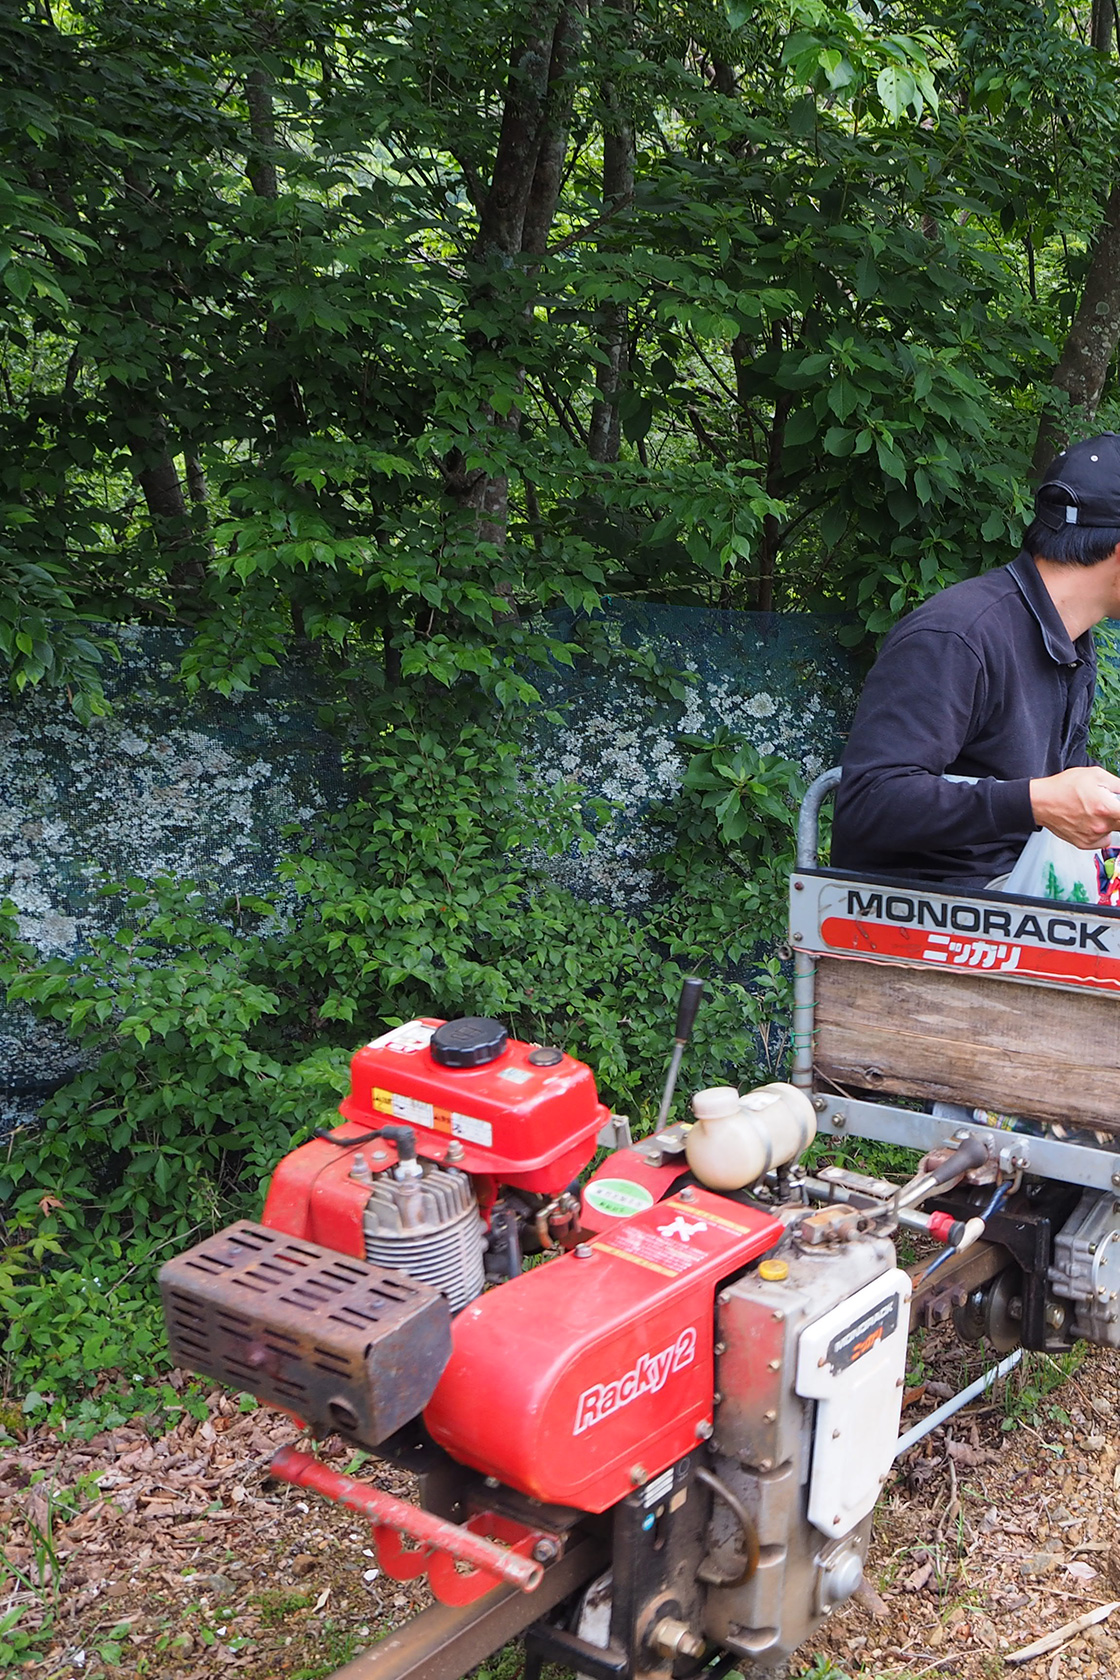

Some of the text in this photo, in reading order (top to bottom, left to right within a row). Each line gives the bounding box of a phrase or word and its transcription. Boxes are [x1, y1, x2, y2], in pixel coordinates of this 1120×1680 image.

[847, 890, 1110, 952] MONORACK
[922, 933, 1021, 970] ニッカリ
[573, 1327, 697, 1436] Racky2
